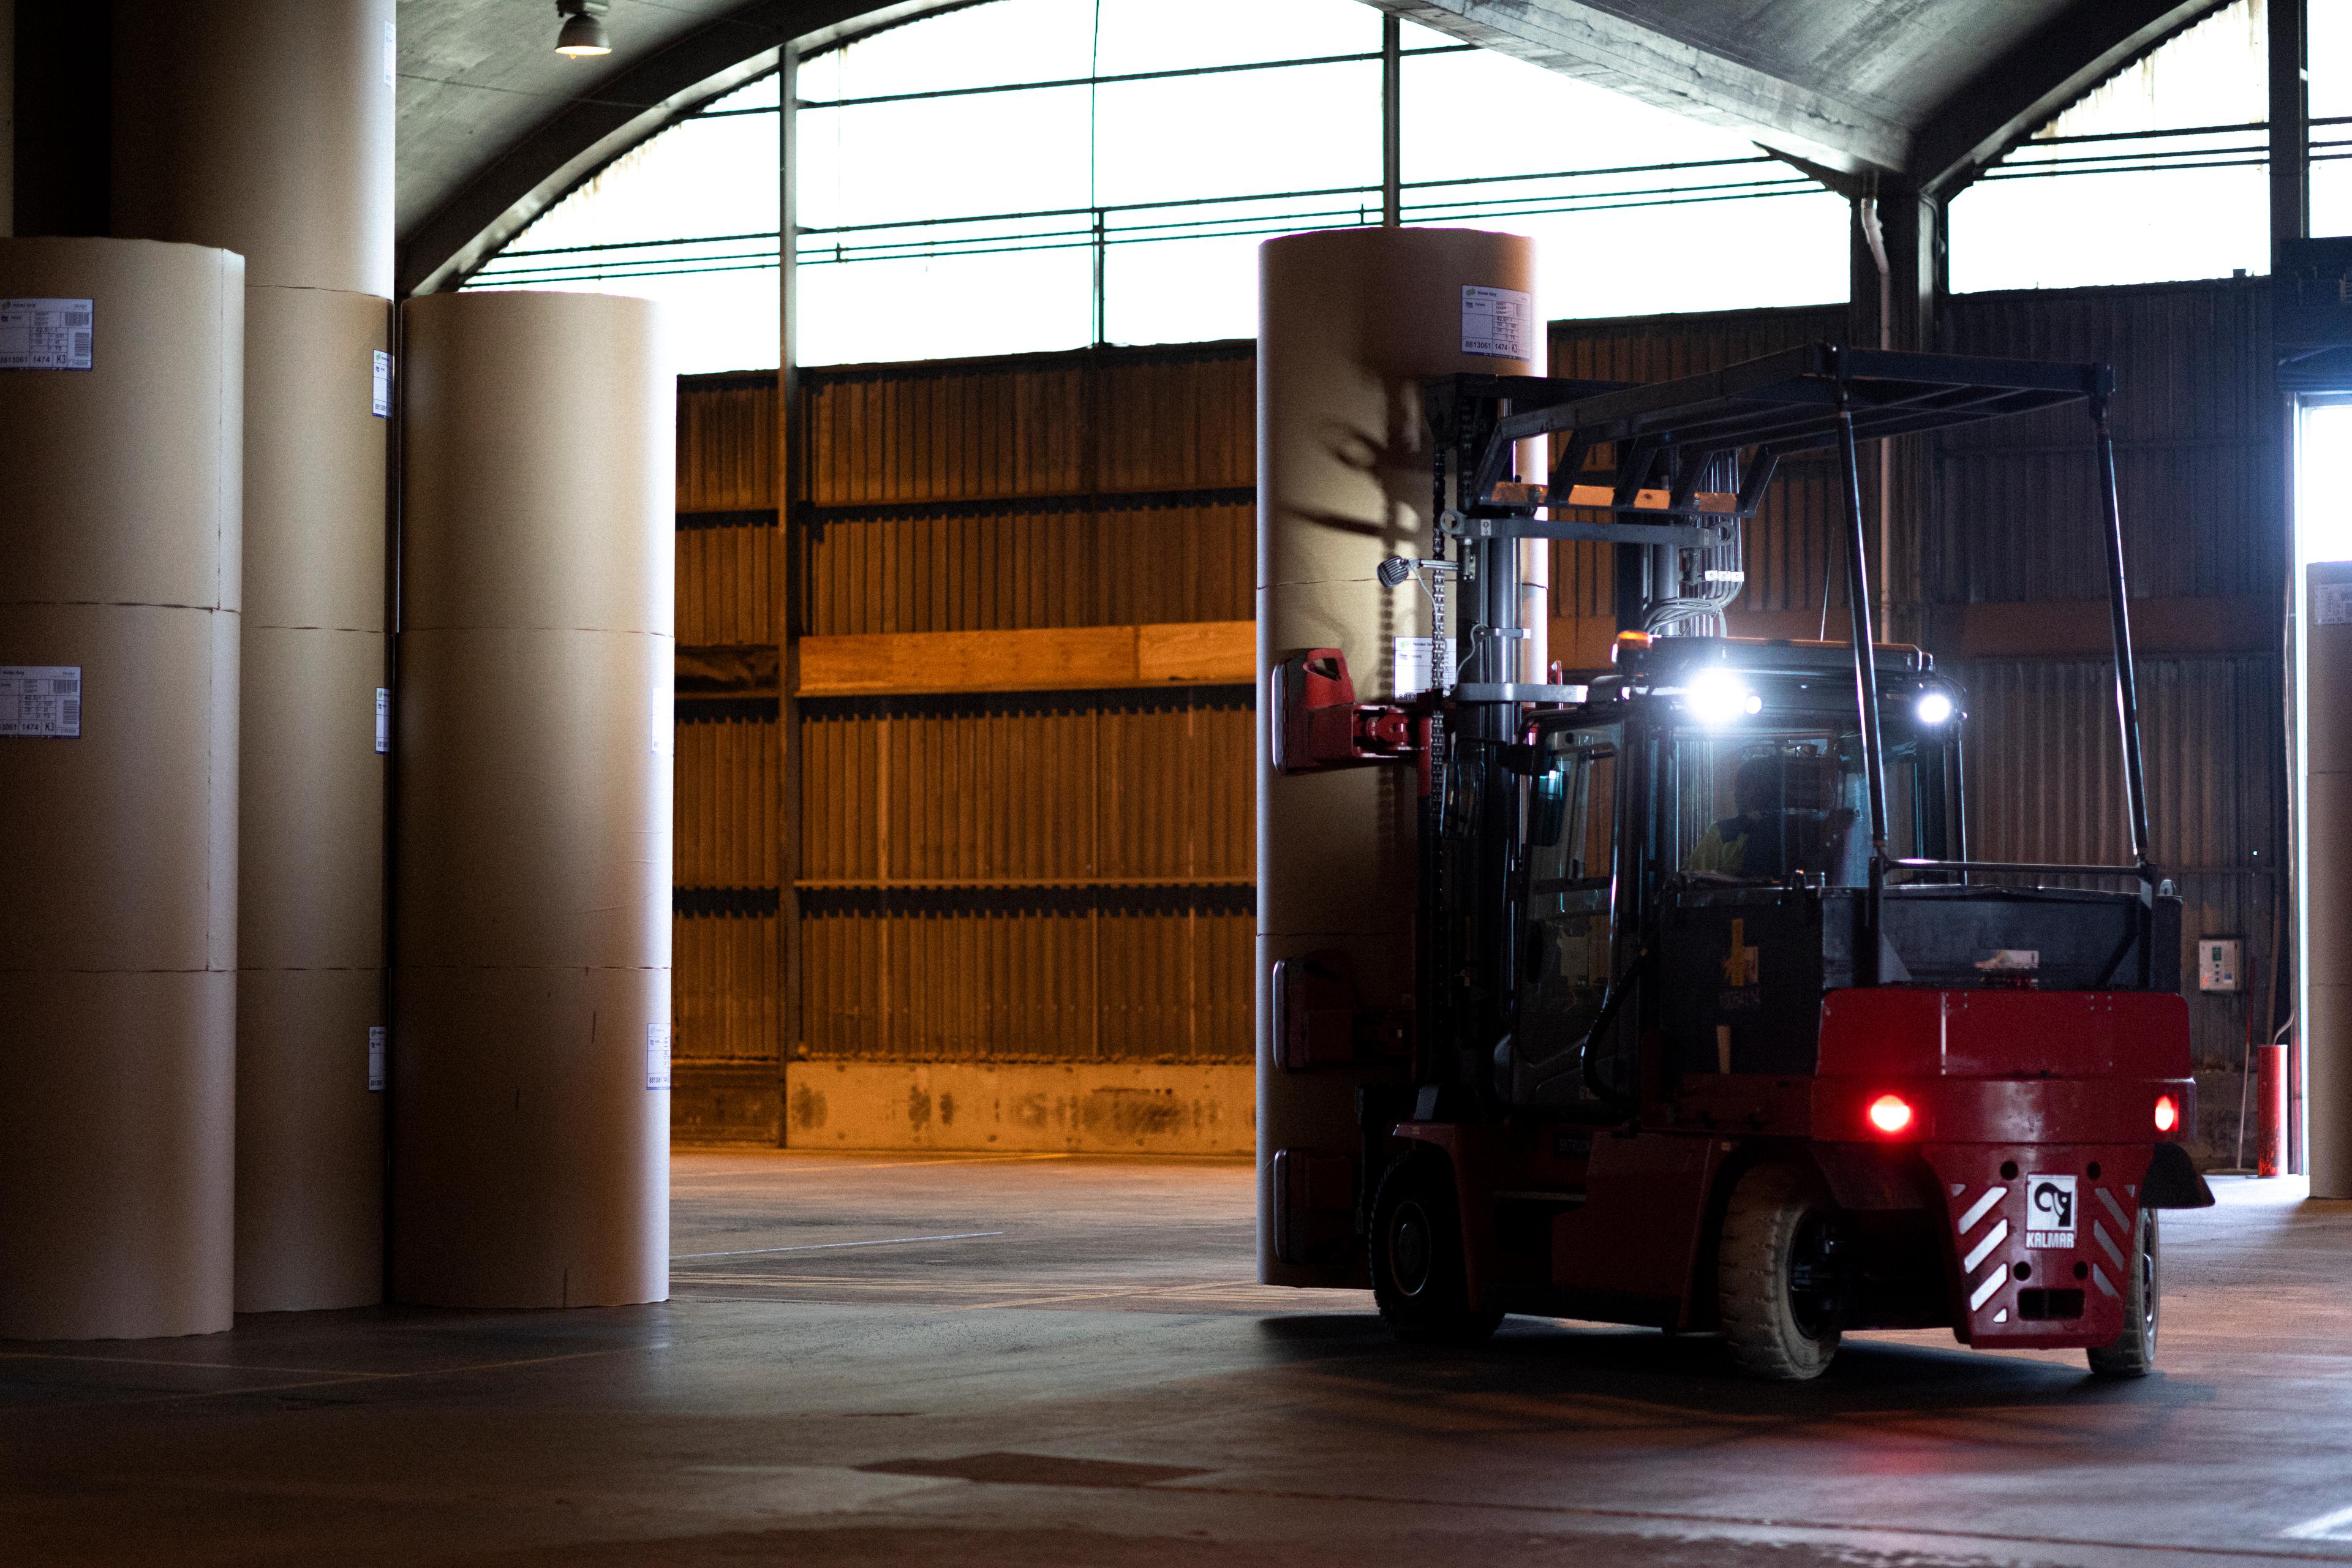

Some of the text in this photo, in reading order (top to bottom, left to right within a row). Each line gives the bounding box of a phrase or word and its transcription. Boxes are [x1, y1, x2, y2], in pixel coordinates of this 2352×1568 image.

[1512, 344, 1517, 353] K3
[56, 354, 66, 364] K3
[45, 722, 55, 732] K3
[2026, 1232, 2075, 1248] KALMAR
